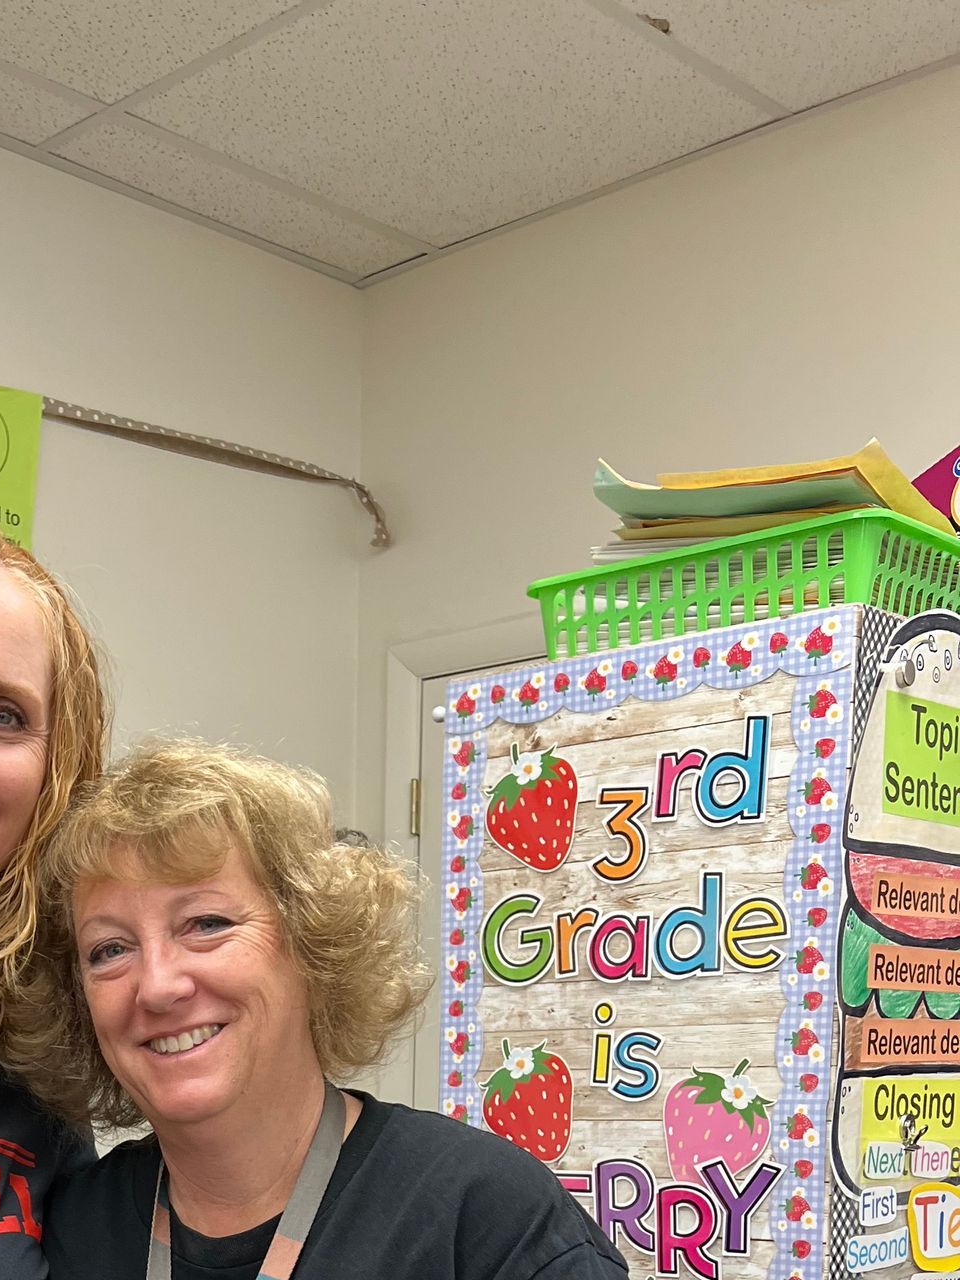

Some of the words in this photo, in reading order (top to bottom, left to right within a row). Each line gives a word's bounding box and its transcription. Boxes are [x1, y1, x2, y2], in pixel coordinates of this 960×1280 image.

[6, 509, 20, 526] to
[592, 714, 773, 882] 3rd
[877, 879, 945, 914] Relevant
[480, 871, 790, 986] Grade
[874, 953, 942, 985] Relevant
[590, 1001, 666, 1099] is
[867, 1028, 937, 1056] Relevant
[874, 1083, 956, 1128] Closing
[867, 1146, 903, 1174] Next
[913, 1146, 950, 1174] Then
[862, 1189, 895, 1221] First
[847, 1231, 907, 1269] Second
